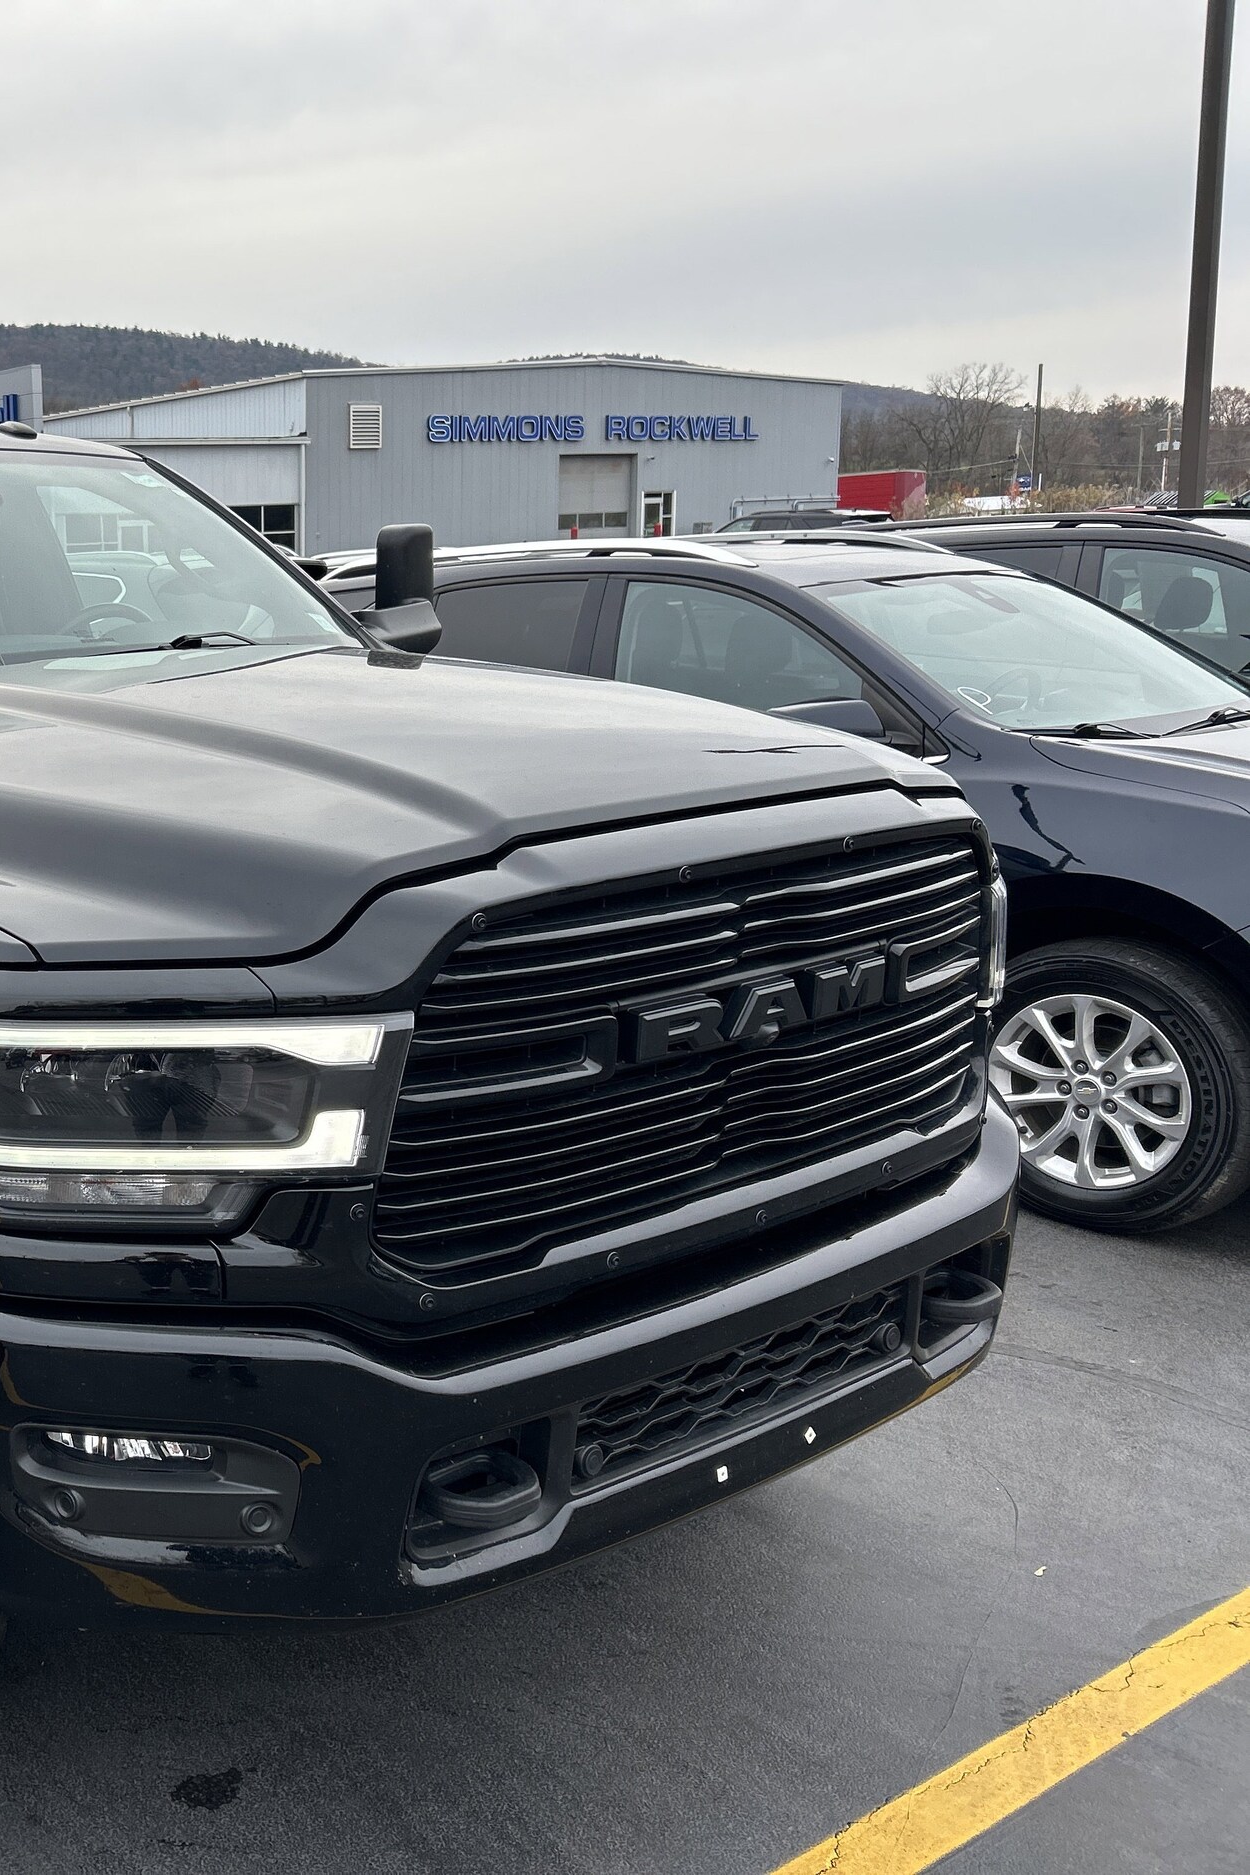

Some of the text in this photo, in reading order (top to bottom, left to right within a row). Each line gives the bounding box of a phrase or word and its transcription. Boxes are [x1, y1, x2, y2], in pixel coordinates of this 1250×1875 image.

[427, 413, 760, 443] SIMMONS ROCKWELL
[627, 949, 888, 1064] RAM
